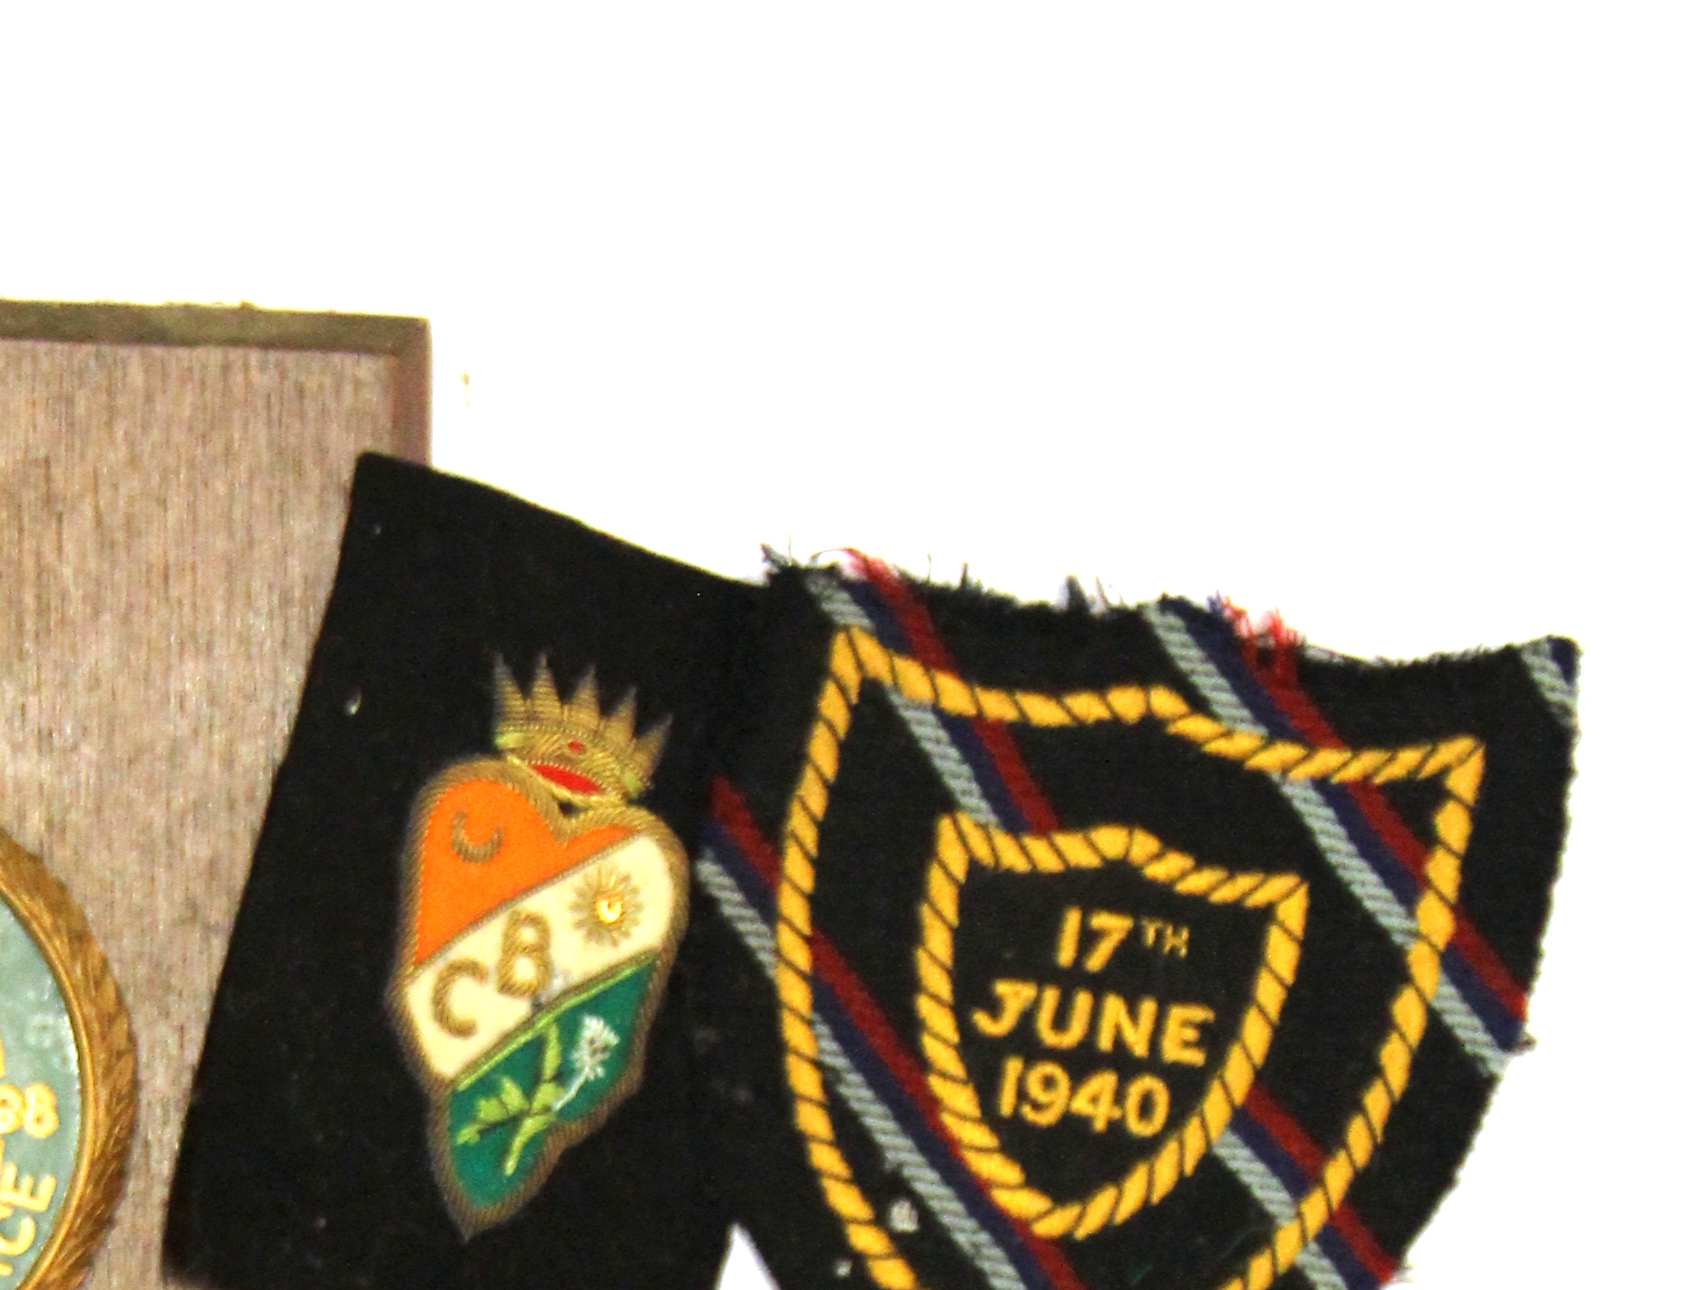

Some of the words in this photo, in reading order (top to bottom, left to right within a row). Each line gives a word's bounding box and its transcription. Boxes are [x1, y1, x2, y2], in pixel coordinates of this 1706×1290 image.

[1057, 905, 1190, 973] 17TH
[971, 978, 1215, 1068] JUNE
[999, 1055, 1170, 1137] 1940
